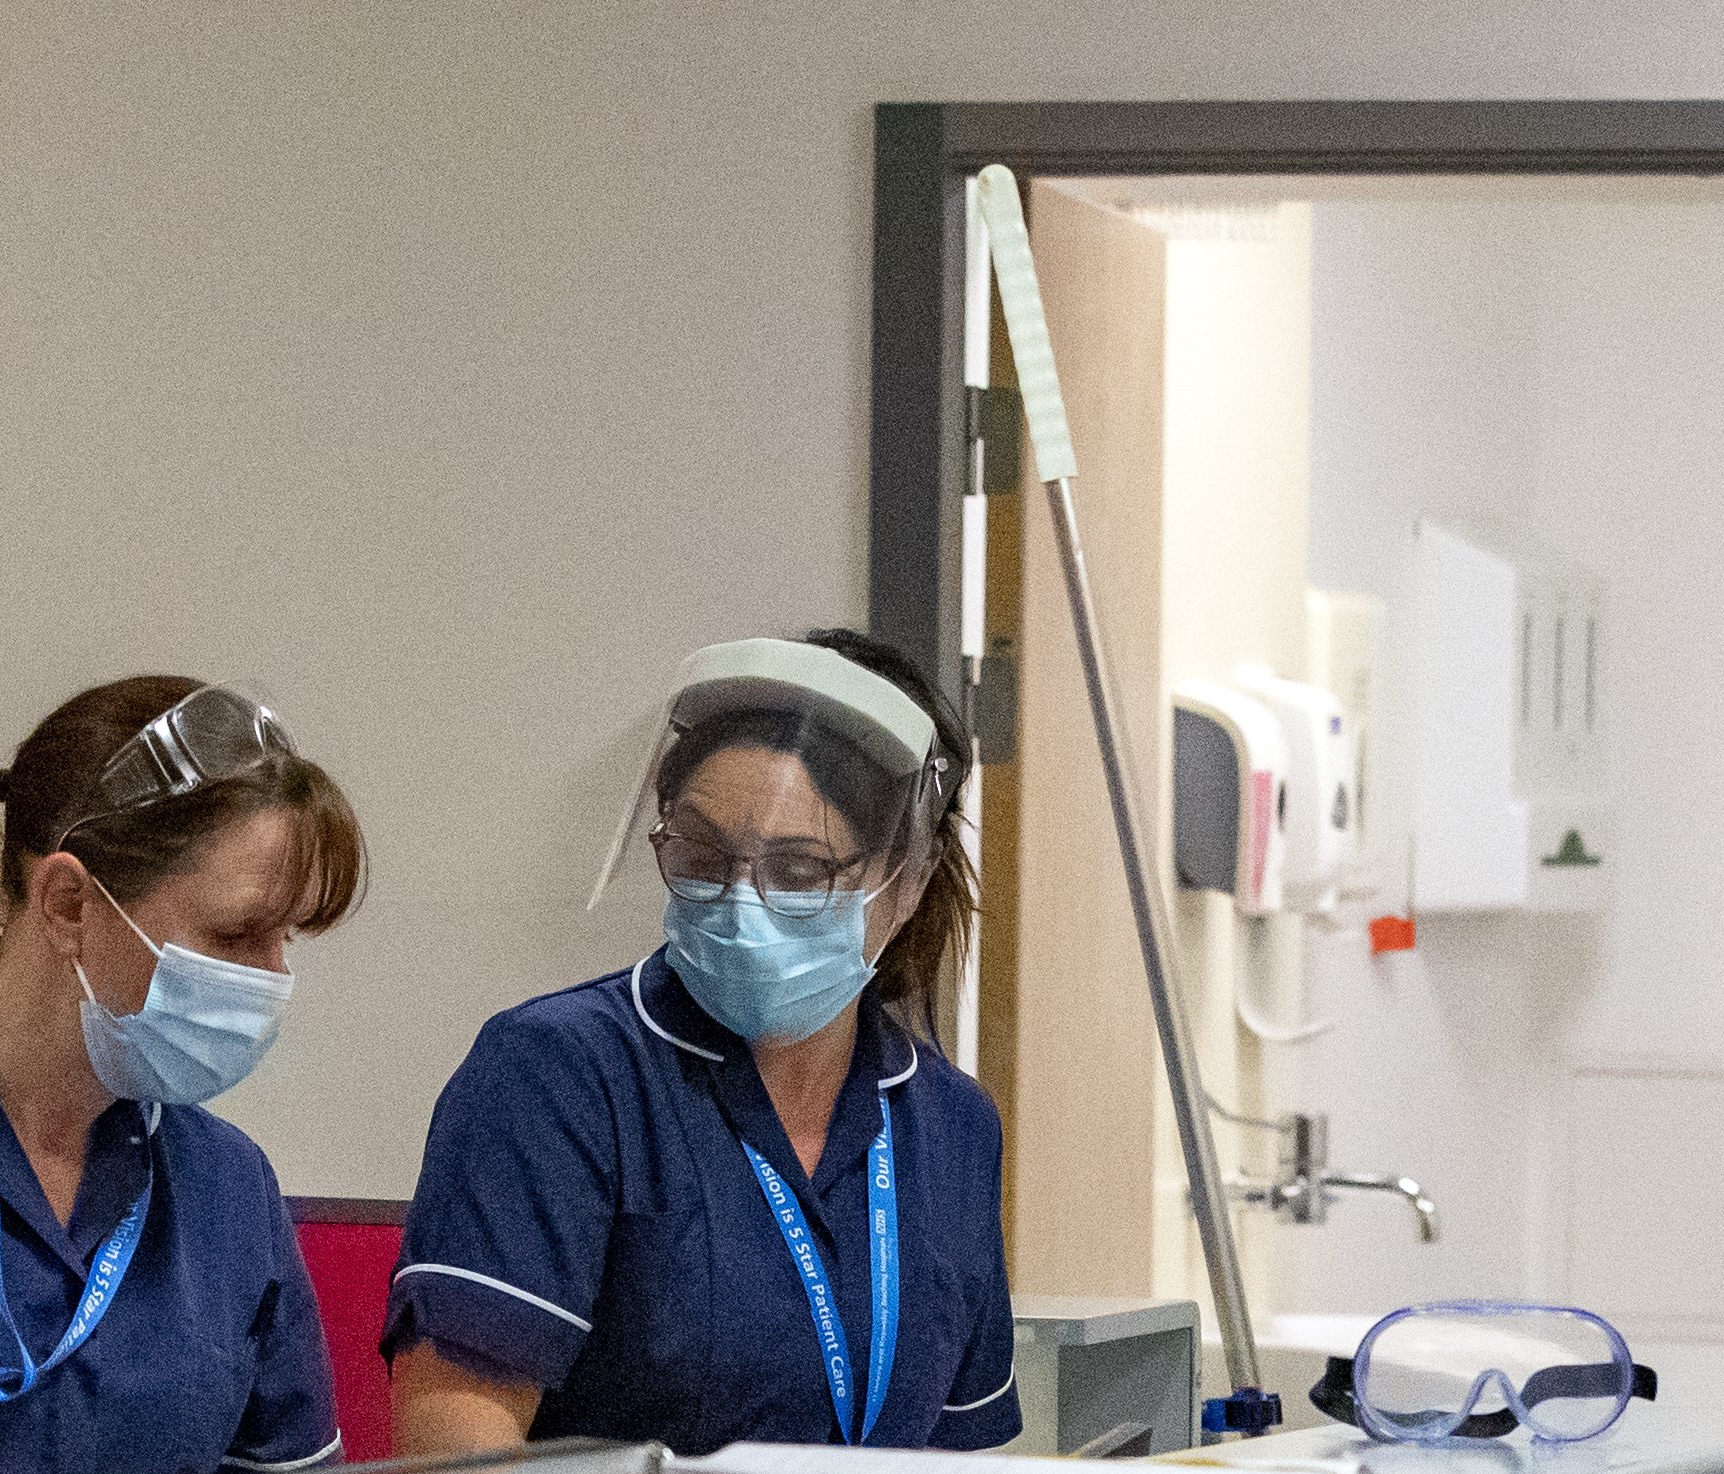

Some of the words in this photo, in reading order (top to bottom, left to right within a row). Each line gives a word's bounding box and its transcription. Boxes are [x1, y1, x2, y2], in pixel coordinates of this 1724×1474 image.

[876, 1156, 889, 1189] Our
[780, 1208, 795, 1224] is
[788, 1227, 804, 1239] 5
[99, 1261, 118, 1277] is
[795, 1242, 819, 1280] Star
[96, 1273, 110, 1291] 5
[84, 1285, 105, 1321] Star
[811, 1284, 840, 1352] Patient
[830, 1355, 847, 1398] Care
